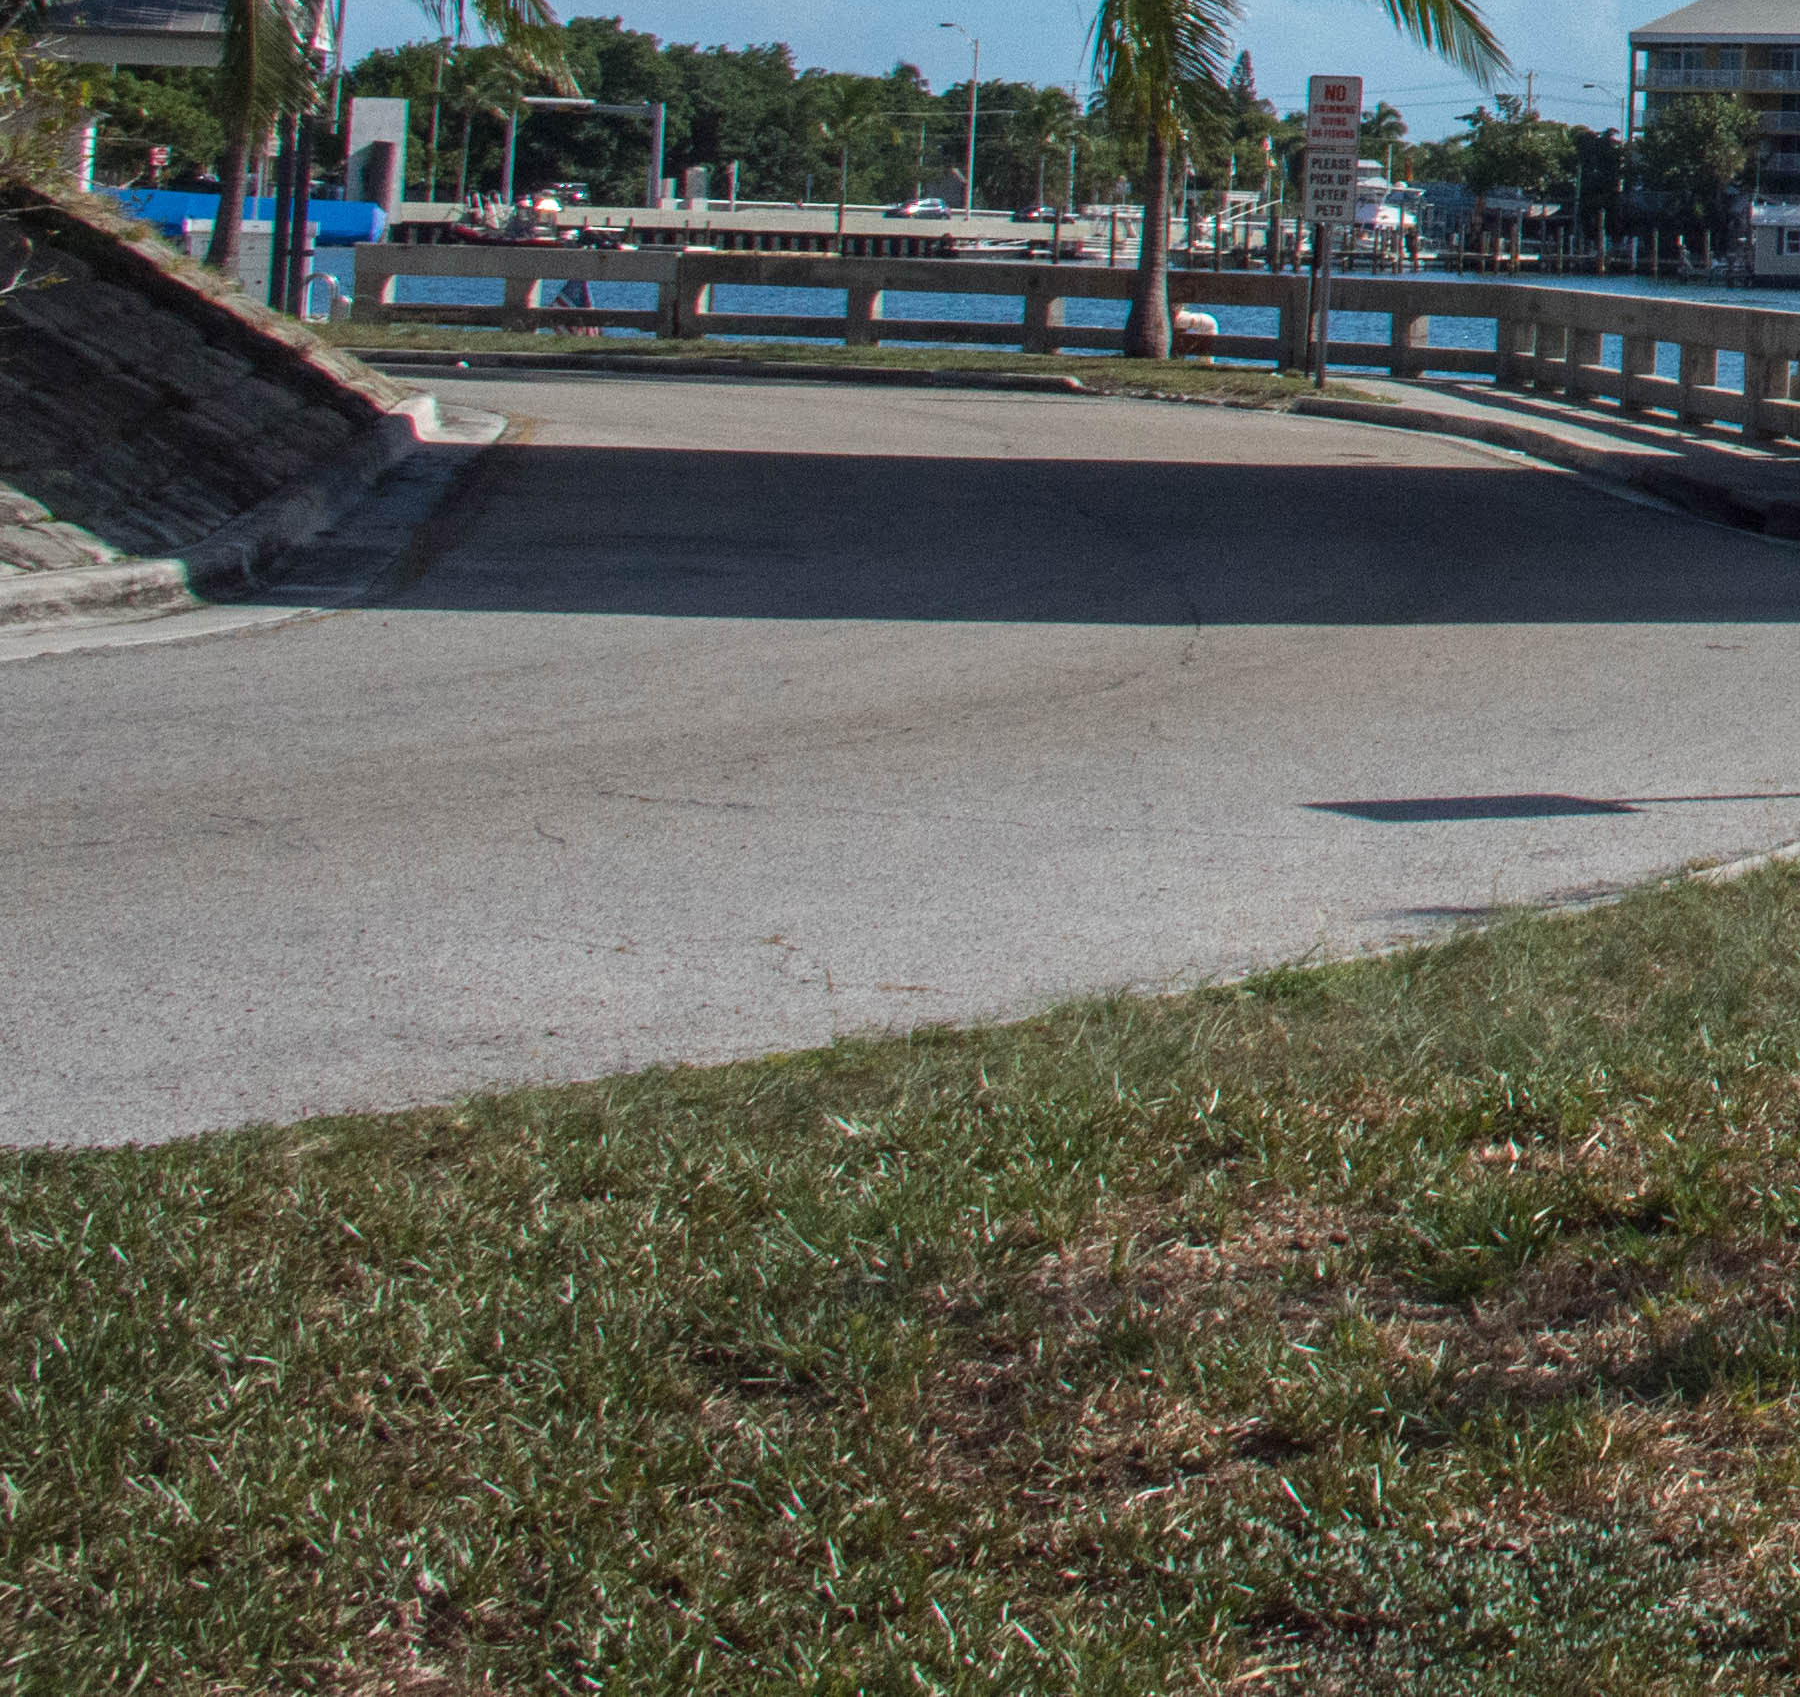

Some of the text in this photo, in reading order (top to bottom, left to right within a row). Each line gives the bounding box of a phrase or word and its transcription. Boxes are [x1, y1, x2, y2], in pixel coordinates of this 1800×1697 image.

[1324, 84, 1346, 101] NO
[1312, 158, 1352, 170] PLEASE
[1310, 173, 1352, 185] PICK UP
[1314, 189, 1348, 201] AFTER
[1315, 205, 1343, 217] PETS
